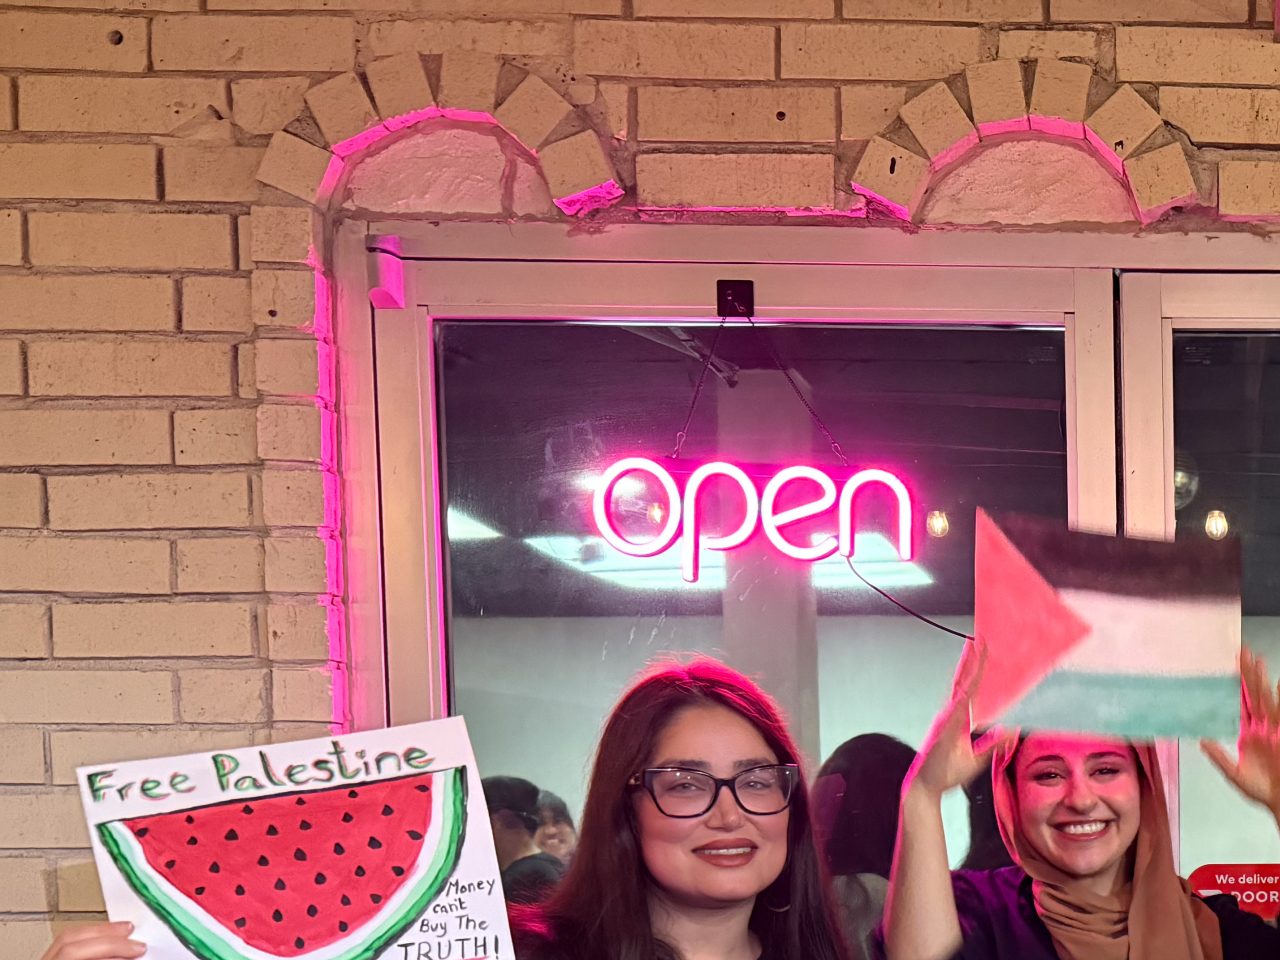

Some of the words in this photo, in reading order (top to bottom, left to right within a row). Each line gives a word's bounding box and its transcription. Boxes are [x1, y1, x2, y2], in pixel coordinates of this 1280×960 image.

[87, 768, 196, 802] Free
[211, 739, 434, 793] Palestine
[446, 879, 495, 897] Money
[1215, 874, 1235, 884] We
[1238, 874, 1279, 884] deliver
[433, 898, 467, 914] can't
[420, 919, 447, 938] Buy
[455, 914, 488, 930] The
